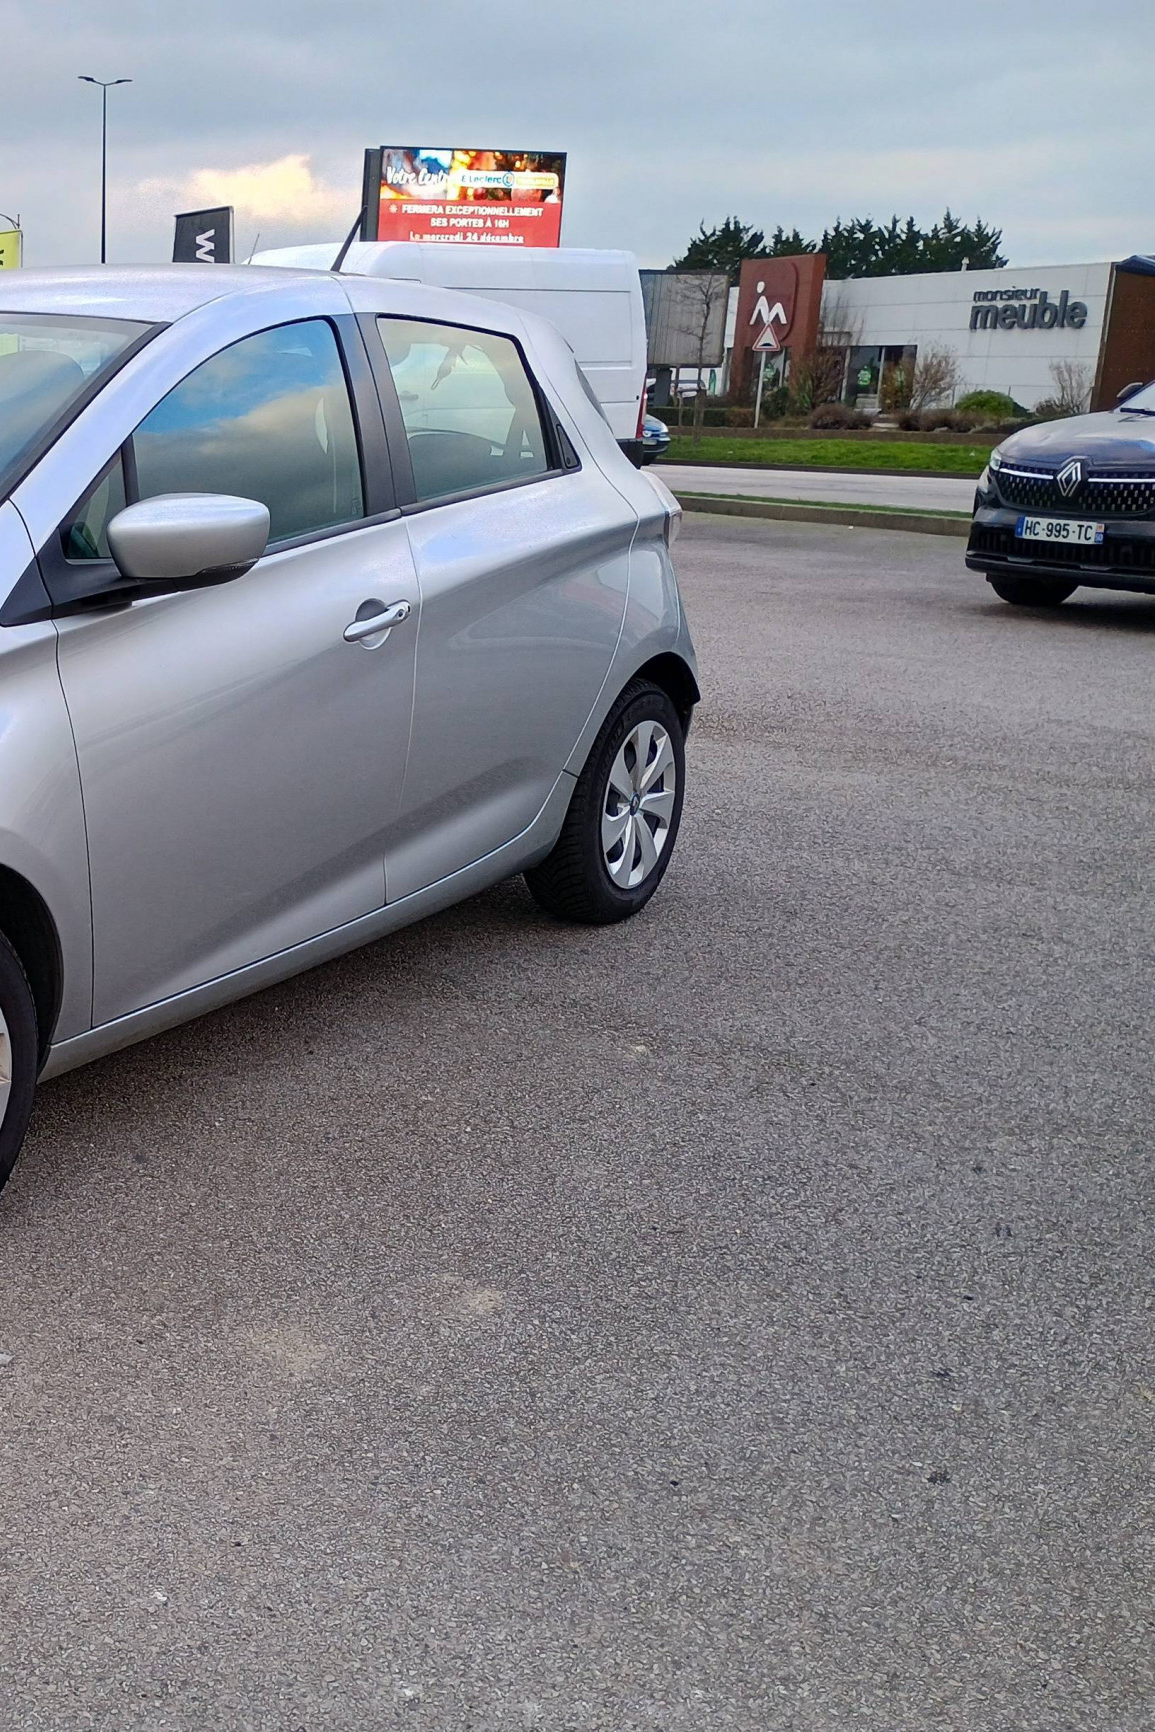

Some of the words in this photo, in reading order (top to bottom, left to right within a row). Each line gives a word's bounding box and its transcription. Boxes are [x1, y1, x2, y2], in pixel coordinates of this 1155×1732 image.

[402, 204, 444, 214] FERMERA
[446, 205, 544, 217] EXCEPTIONNELLEMENT
[430, 217, 448, 227] SES
[449, 218, 484, 229] PORTES
[422, 231, 464, 242] mercredi
[973, 286, 1041, 302] monsieur
[969, 290, 1087, 332] meuble
[1024, 520, 1093, 541] HC-995-TC
